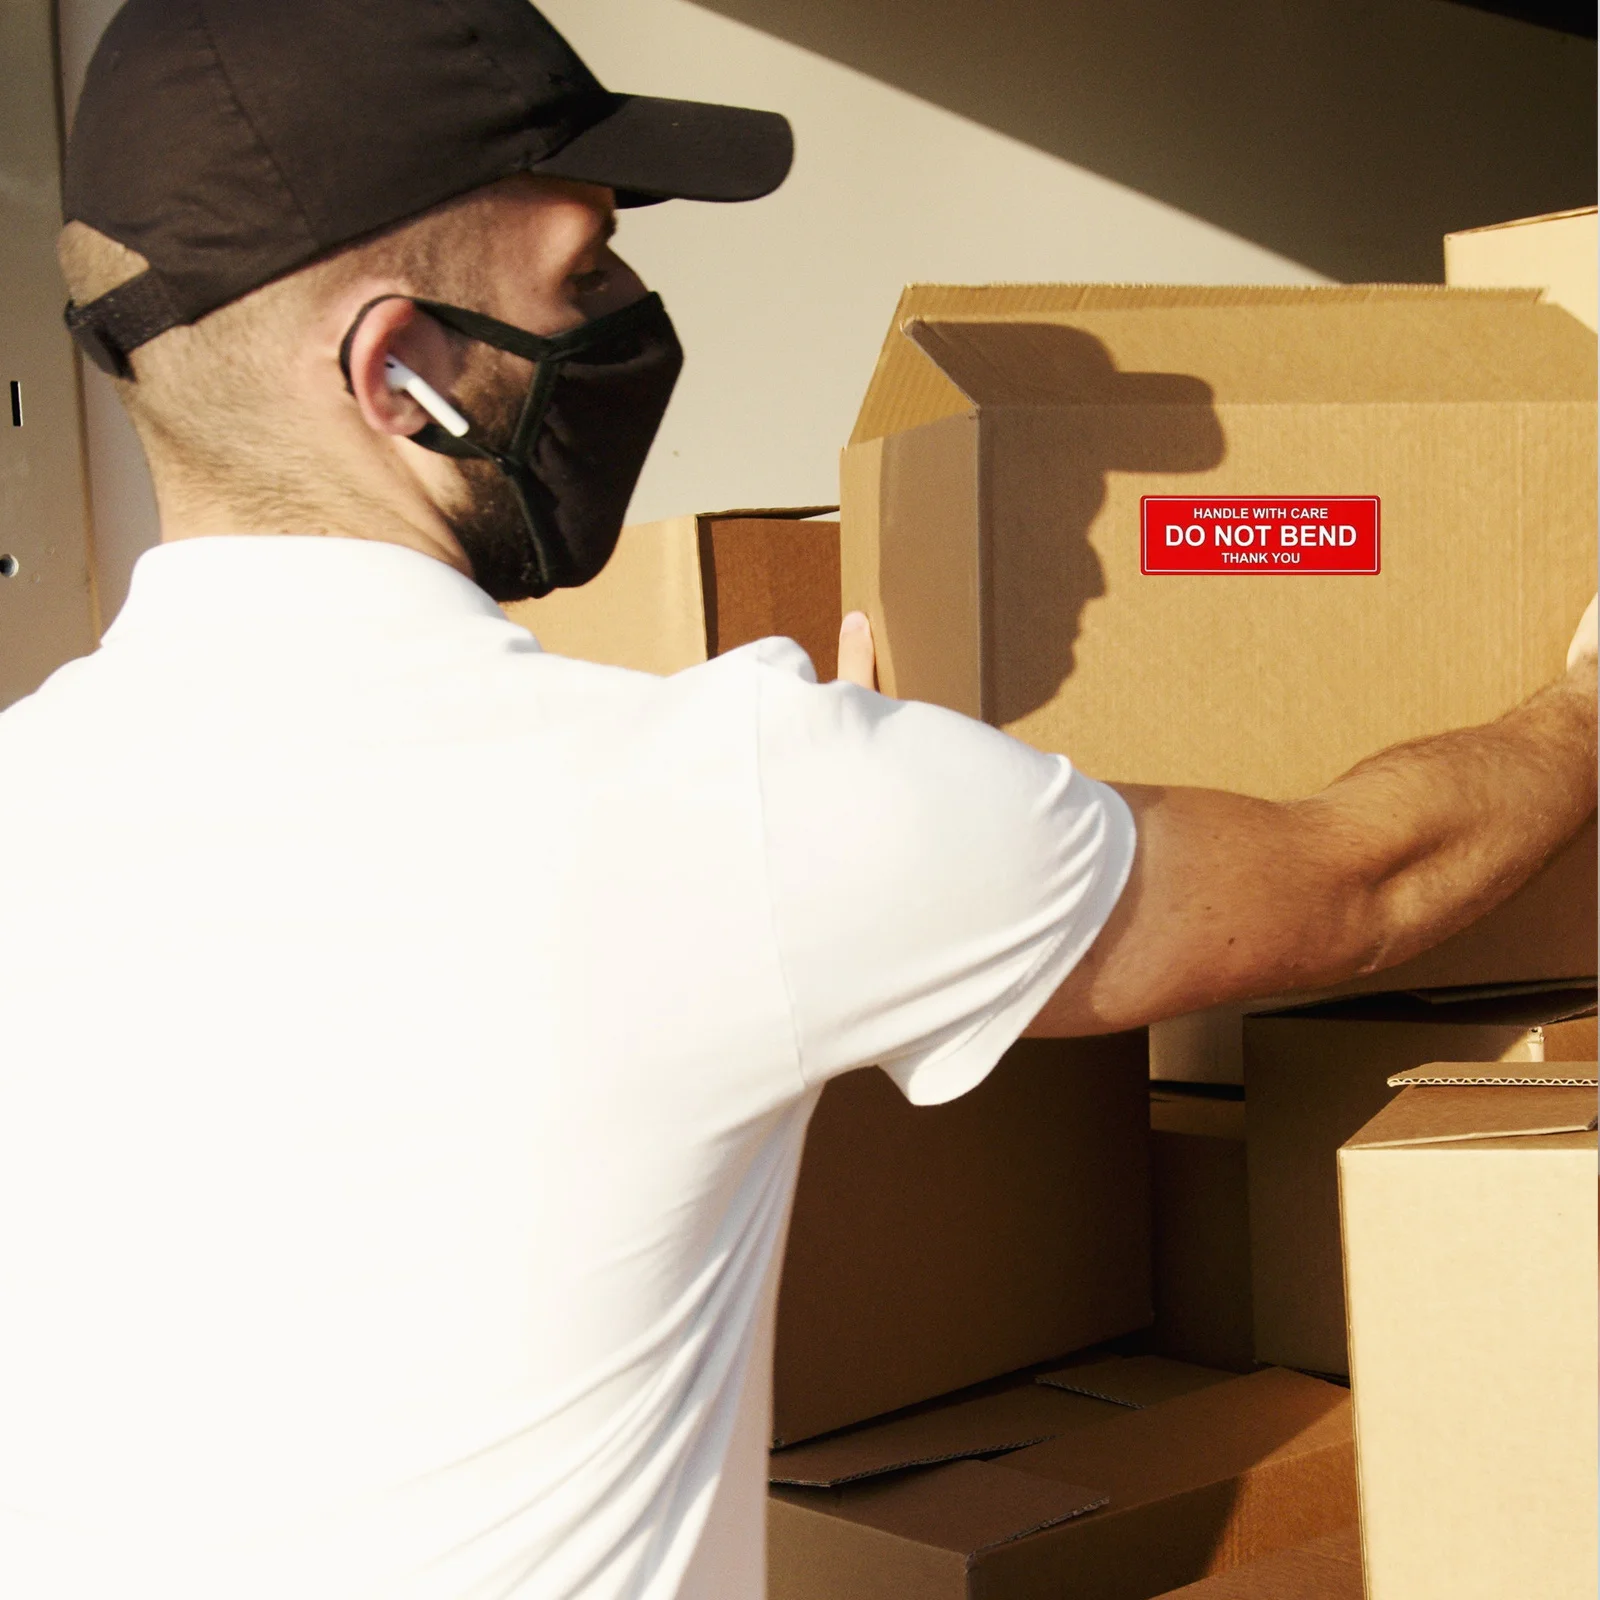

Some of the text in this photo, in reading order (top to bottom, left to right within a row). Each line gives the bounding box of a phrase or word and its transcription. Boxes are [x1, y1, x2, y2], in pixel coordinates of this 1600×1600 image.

[1193, 507, 1329, 518] HANDLE WITH CARE
[1165, 525, 1357, 547] DO NOT BEND
[1221, 552, 1300, 563] THANK YOU
